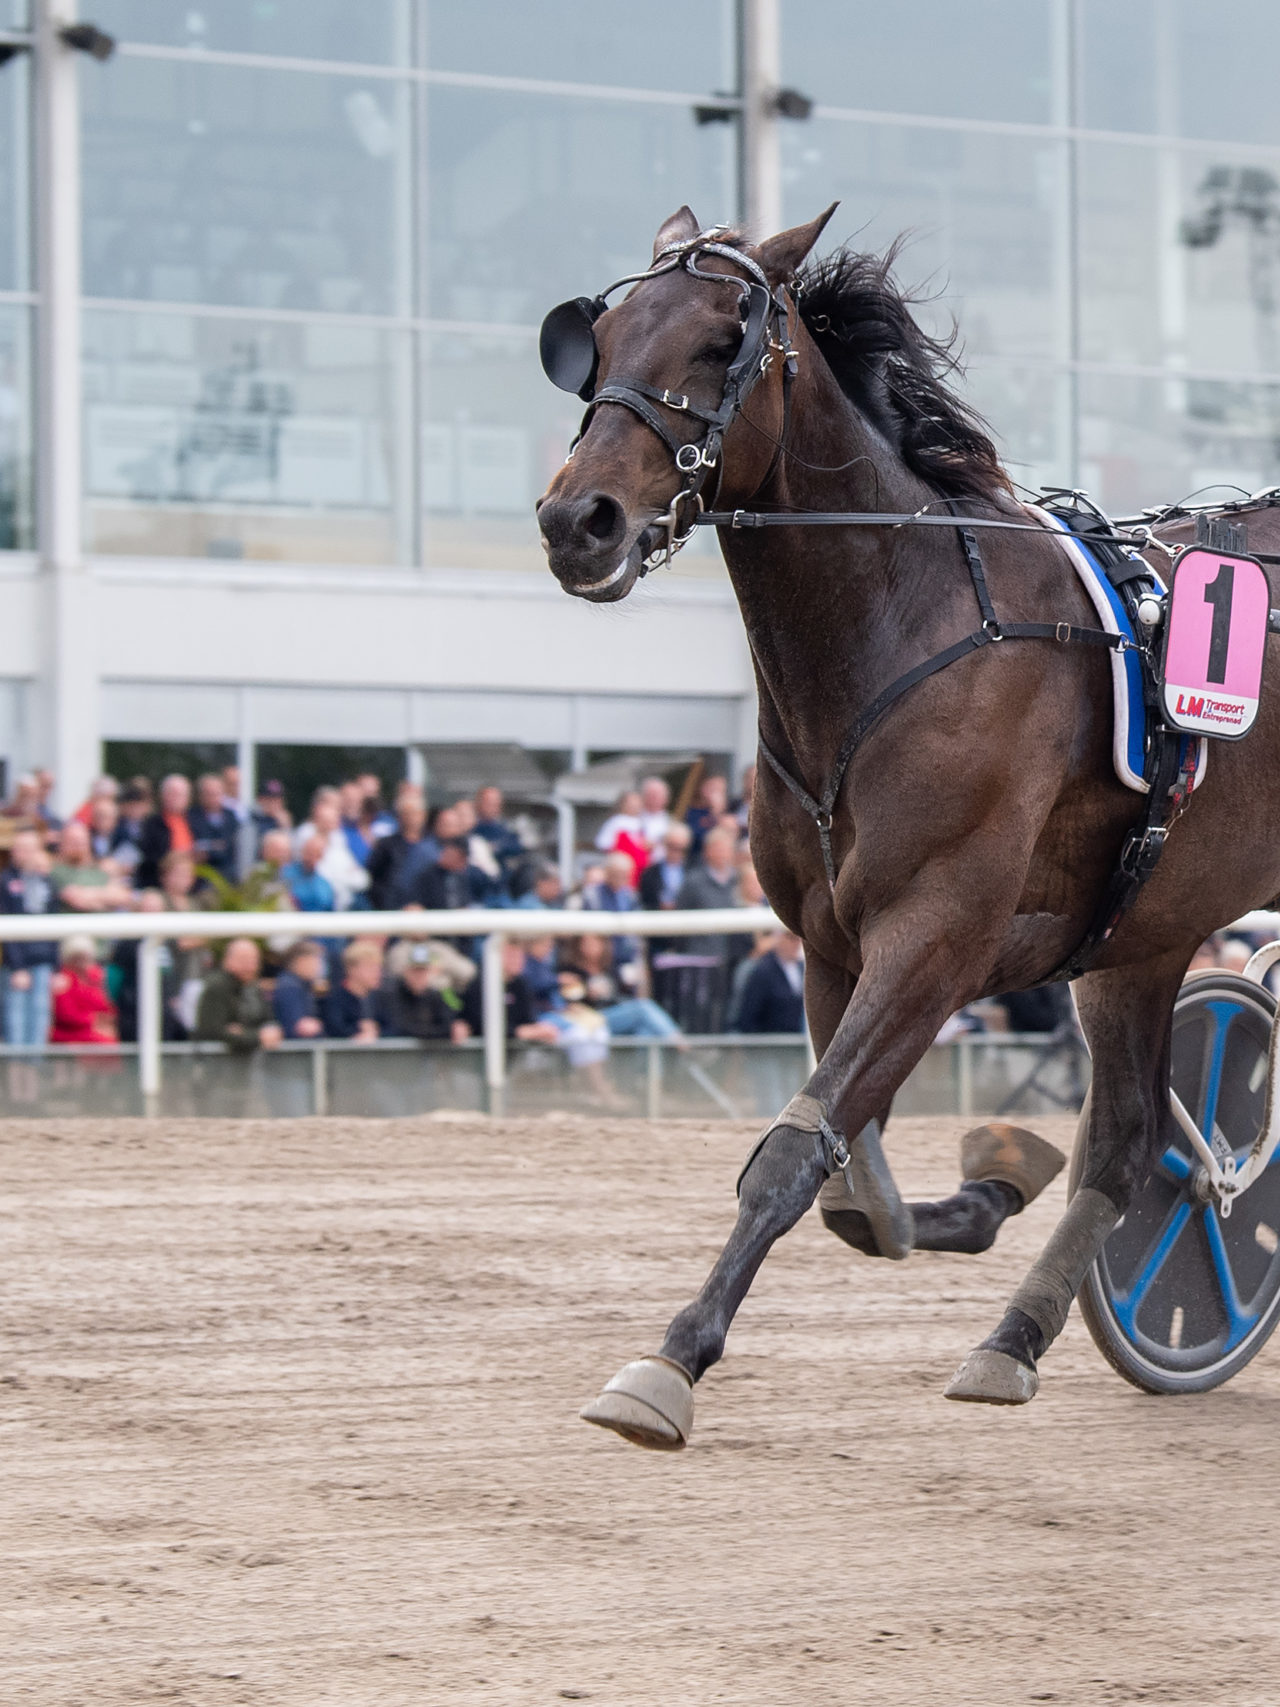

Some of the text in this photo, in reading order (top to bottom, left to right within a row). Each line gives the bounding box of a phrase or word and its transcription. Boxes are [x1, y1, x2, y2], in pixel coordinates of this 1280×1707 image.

[1204, 564, 1235, 685] 1
[1176, 694, 1246, 718] LM Transport
[1202, 711, 1243, 726] Entreprenad
